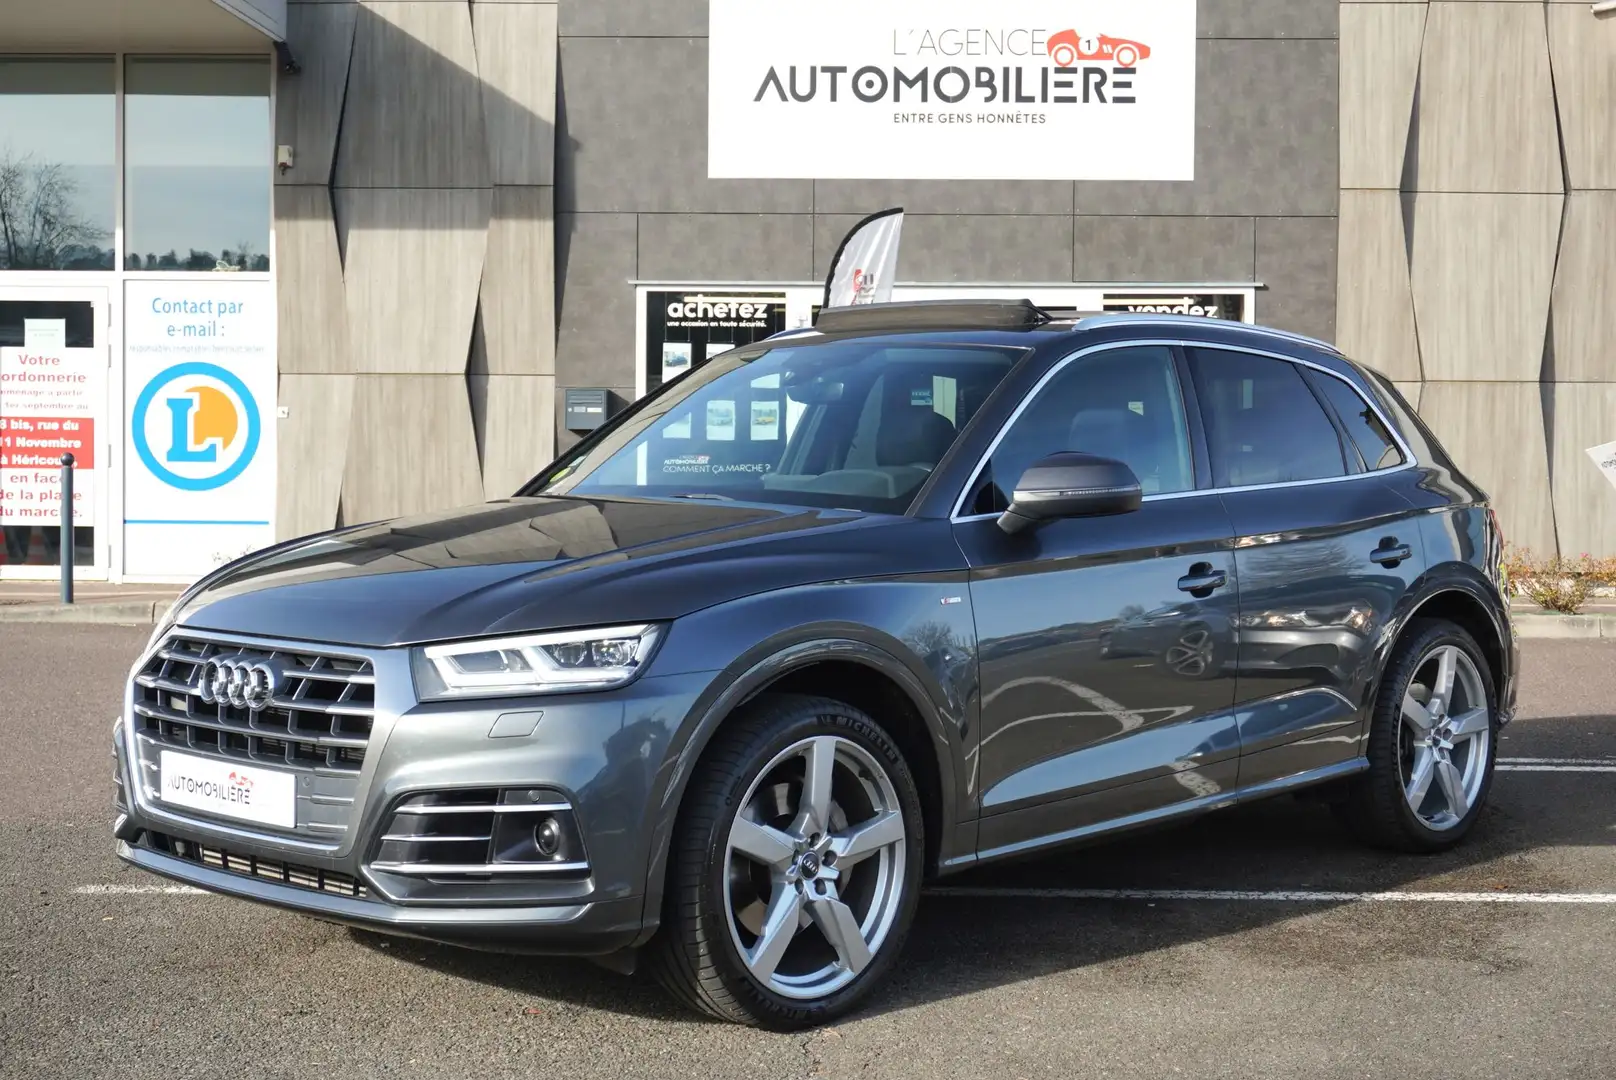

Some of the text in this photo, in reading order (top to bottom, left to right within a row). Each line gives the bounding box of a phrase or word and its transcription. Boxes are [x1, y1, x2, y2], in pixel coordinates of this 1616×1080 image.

[893, 110, 1046, 124] ENTRE GENS HONNÊTES
[152, 297, 244, 317] Contact par
[667, 294, 768, 319] achetez
[167, 320, 216, 337] e-mail
[18, 354, 61, 366] Votre
[1, 371, 87, 383] ordonnerie
[10, 419, 34, 432] bis,
[37, 421, 60, 431] rue
[63, 420, 79, 431] du
[16, 437, 82, 449] Novembre
[1, 454, 78, 468] à Héricou,
[662, 465, 710, 473] COMMENT
[711, 464, 724, 475] ÇA
[725, 464, 763, 473] MARCHE
[10, 474, 28, 484] en
[20, 489, 34, 500] la
[39, 489, 82, 502] plae
[836, 716, 899, 764] MICHELIN
